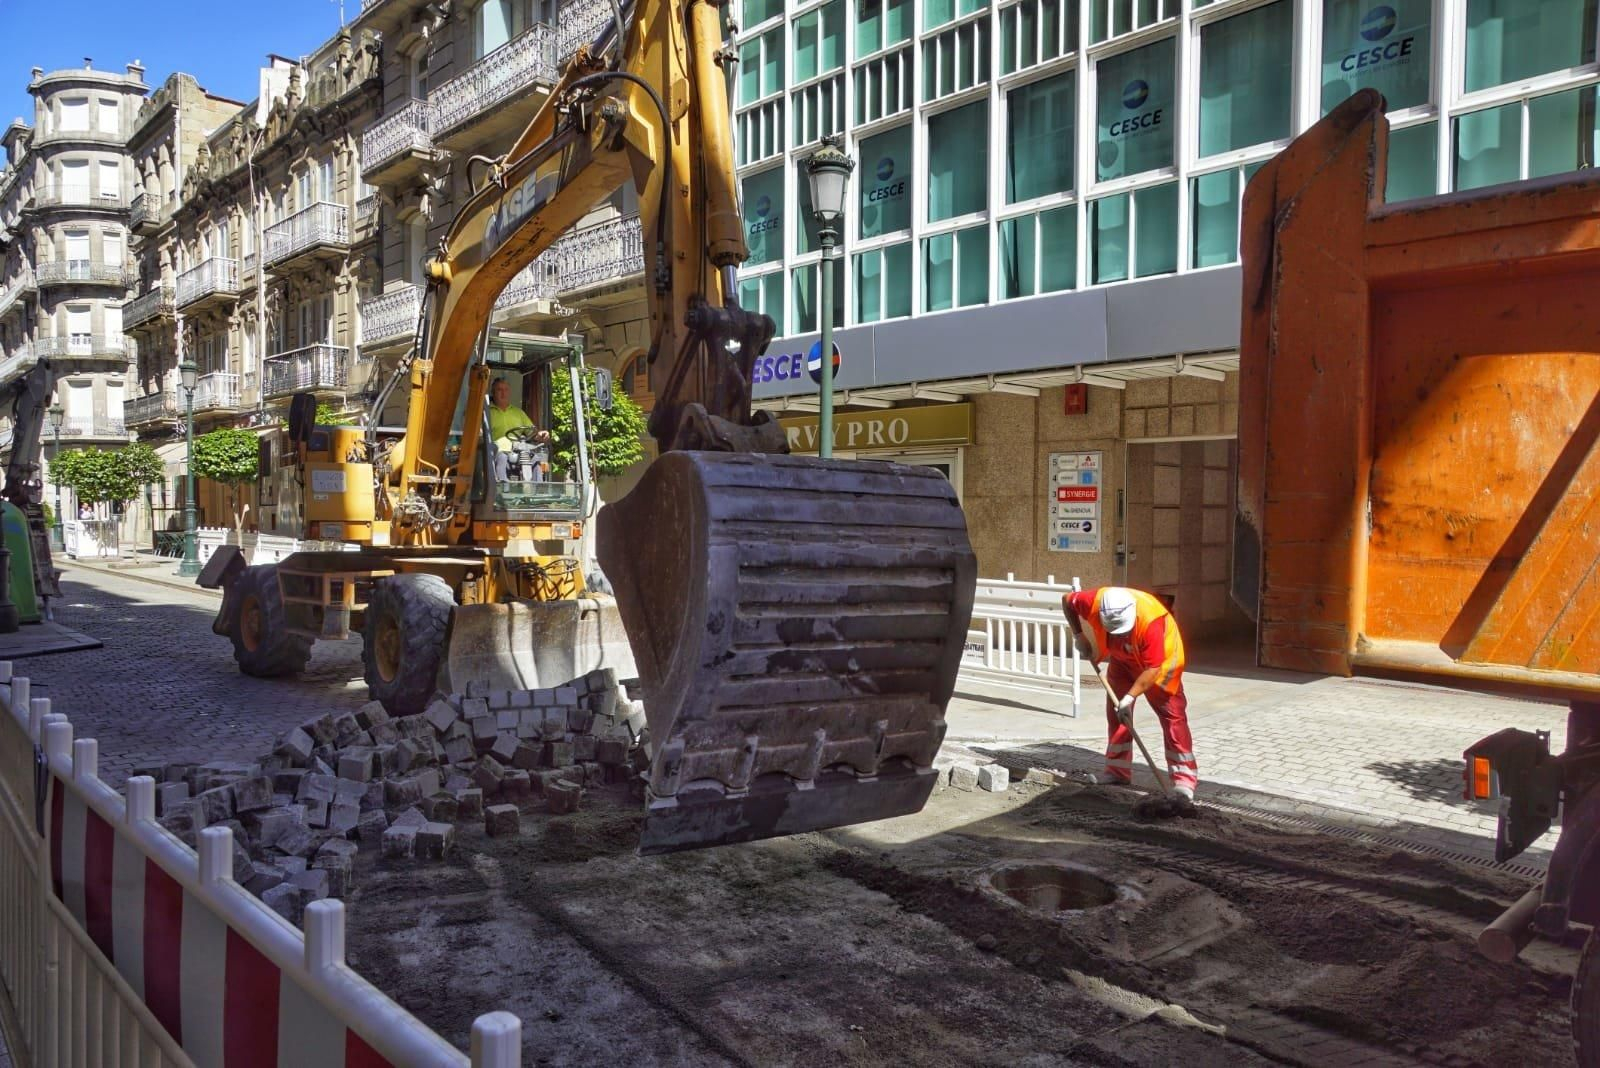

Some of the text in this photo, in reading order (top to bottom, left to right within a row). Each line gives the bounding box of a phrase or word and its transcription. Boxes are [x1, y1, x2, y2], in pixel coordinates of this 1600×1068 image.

[1341, 37, 1414, 72] CESCE
[1109, 109, 1163, 137] CESCE
[869, 182, 905, 202] CESCE
[750, 217, 779, 235] CESCE
[752, 353, 803, 384] ESCE
[1067, 490, 1096, 498] SYNERGIE
[1051, 506, 1057, 514] 2
